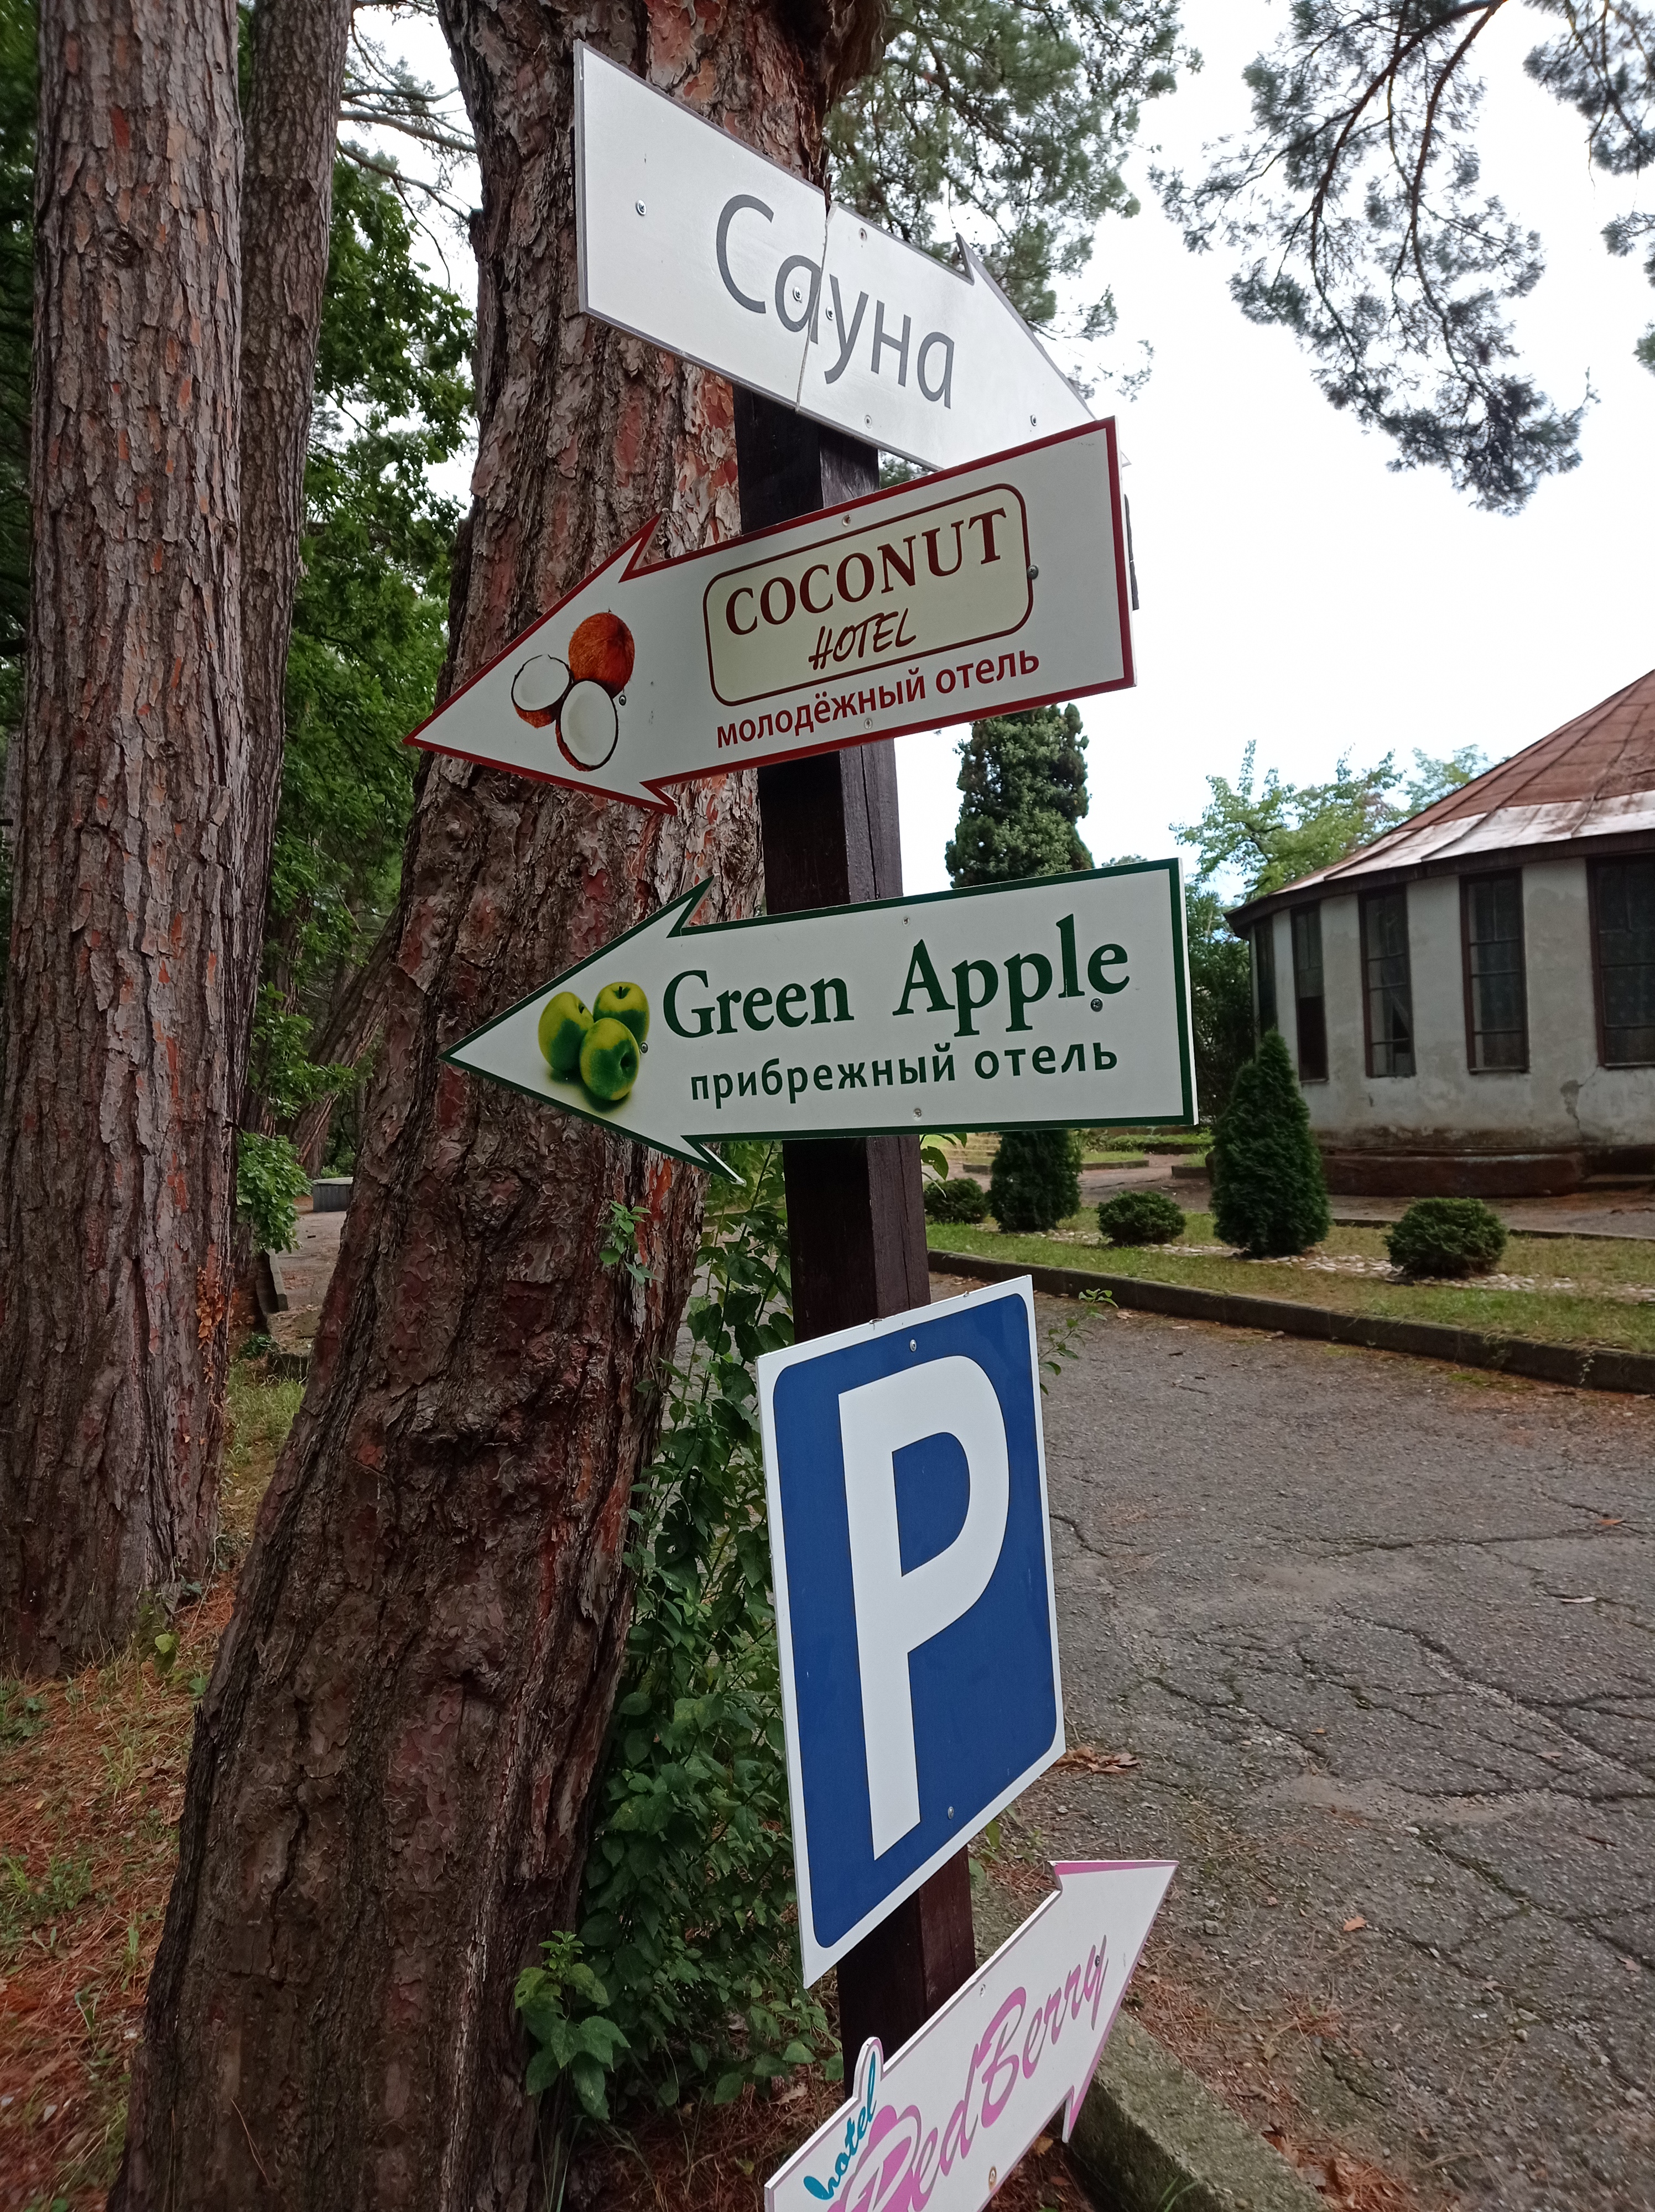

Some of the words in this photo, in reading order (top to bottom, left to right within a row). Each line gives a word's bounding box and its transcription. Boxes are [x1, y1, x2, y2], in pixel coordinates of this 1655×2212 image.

[716, 194, 955, 409] Сауна
[725, 507, 1007, 635] COCONUT
[716, 667, 926, 748] молодёжный
[935, 649, 1040, 695] отель
[808, 608, 917, 671] HOTEL
[663, 969, 855, 1039] Green
[892, 913, 1130, 1037] Apple
[690, 1042, 955, 1109] прибрежный
[974, 1041, 1118, 1079] отель
[838, 1355, 1010, 1860] P
[803, 2051, 877, 2200] hotel
